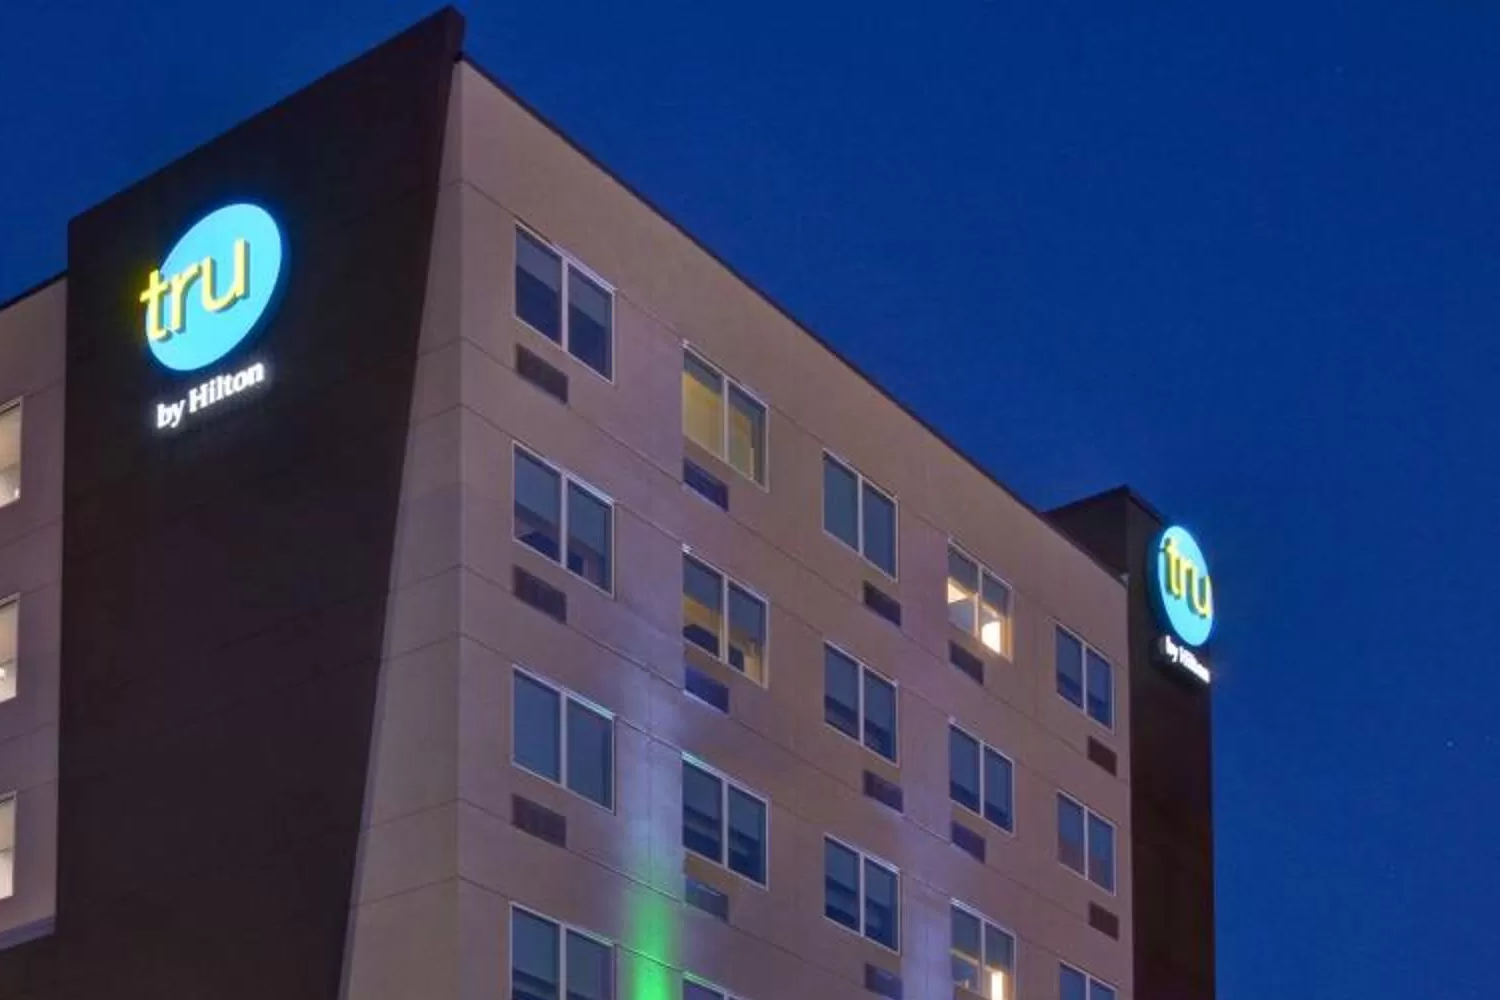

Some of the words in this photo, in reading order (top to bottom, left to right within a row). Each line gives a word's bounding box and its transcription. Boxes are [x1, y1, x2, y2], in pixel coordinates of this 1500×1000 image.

[140, 238, 249, 341] tru
[156, 399, 187, 429] by
[188, 361, 265, 413] Hilton
[1164, 536, 1213, 618] tru
